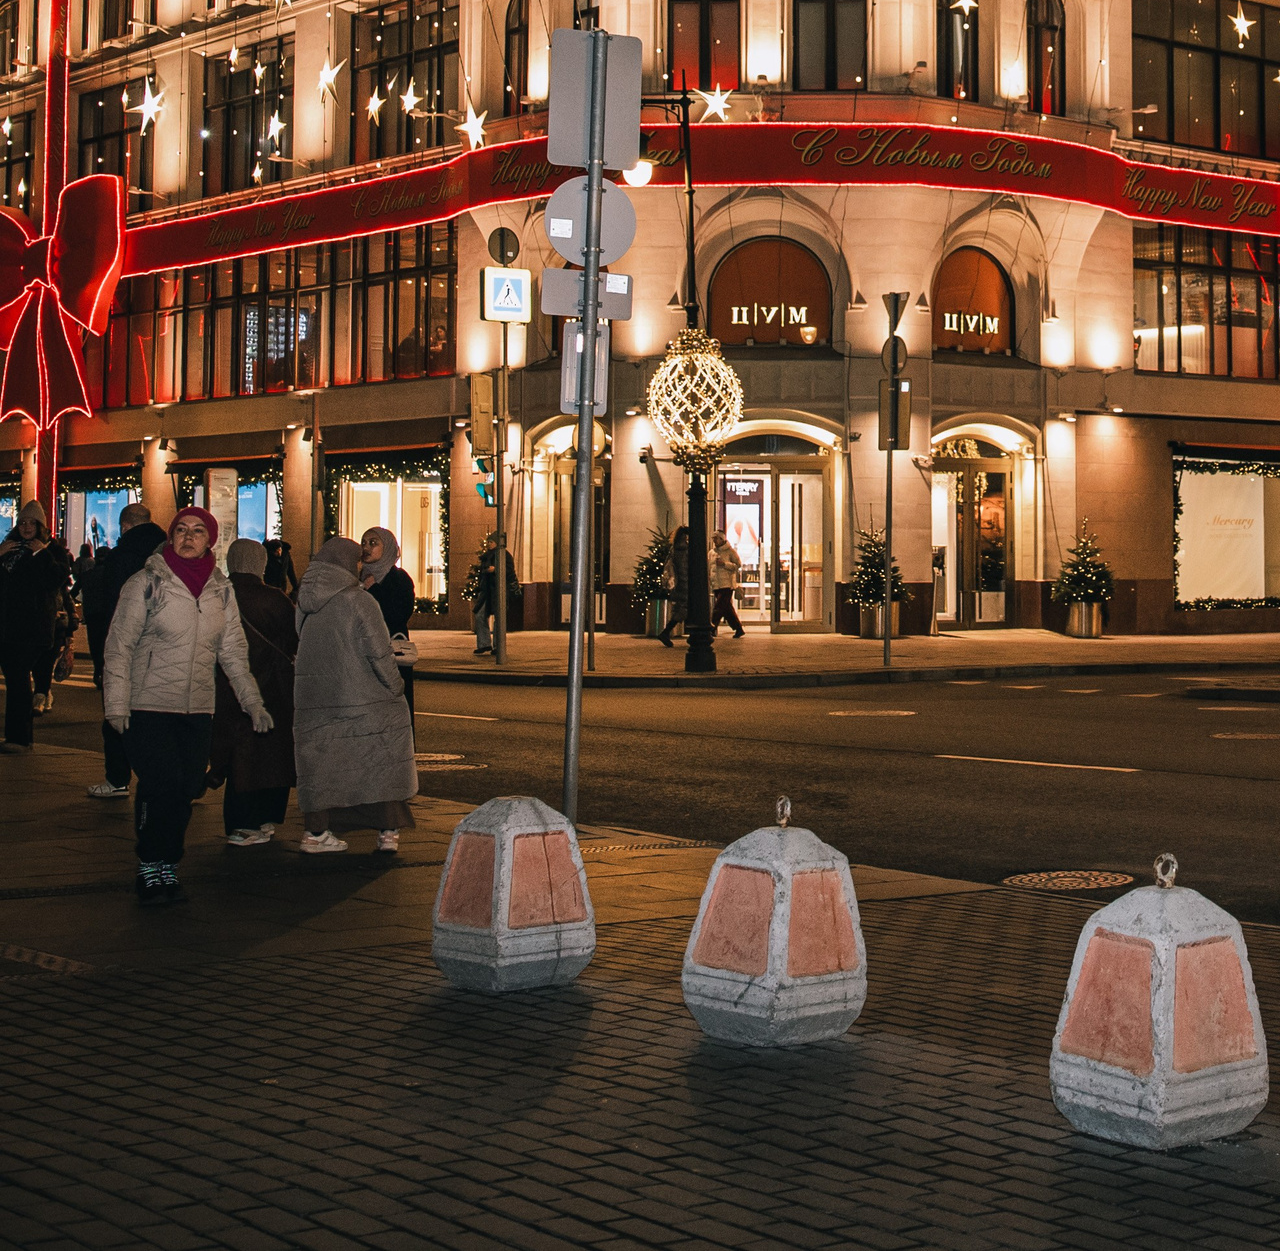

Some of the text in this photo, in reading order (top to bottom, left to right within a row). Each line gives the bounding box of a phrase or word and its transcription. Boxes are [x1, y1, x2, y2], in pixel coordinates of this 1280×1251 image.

[1120, 166, 1277, 223] Happy New Year
[1206, 514, 1255, 530] Mercury
